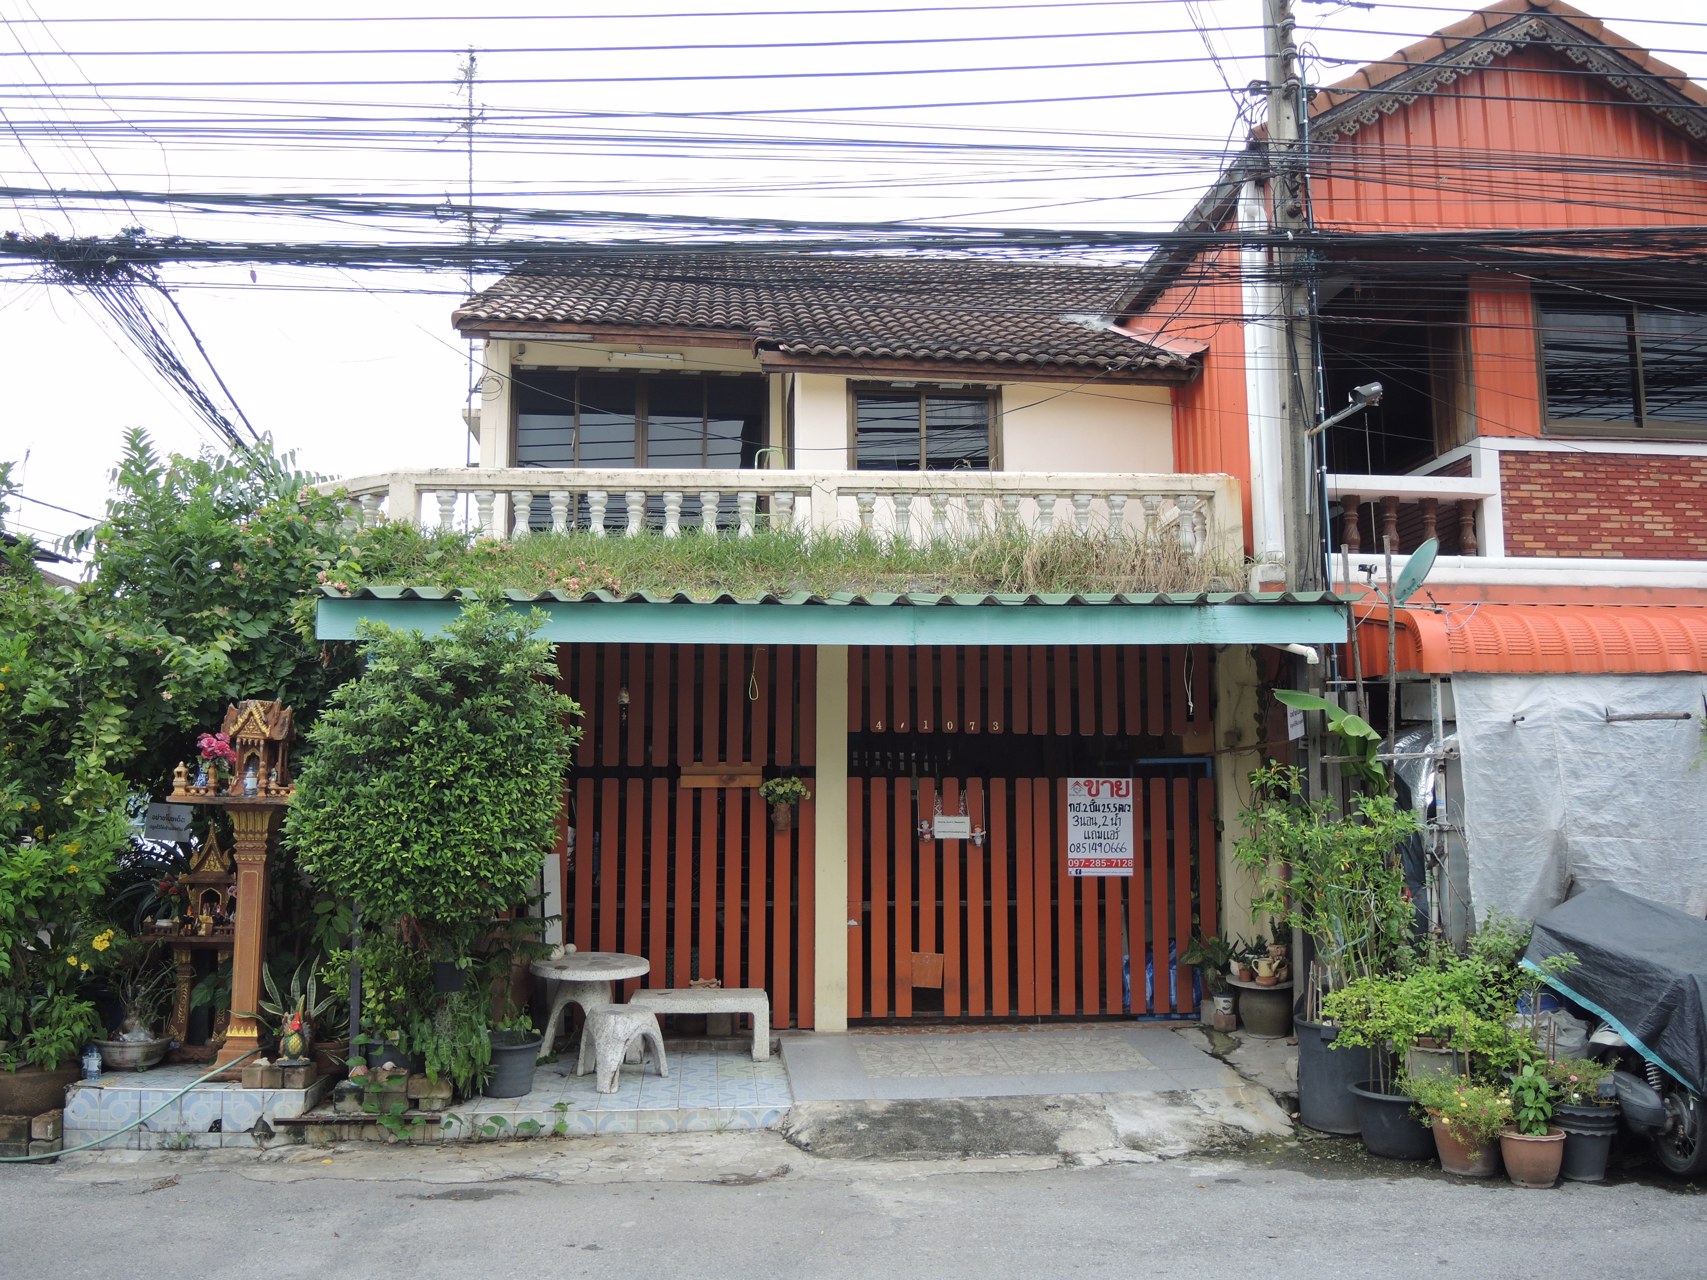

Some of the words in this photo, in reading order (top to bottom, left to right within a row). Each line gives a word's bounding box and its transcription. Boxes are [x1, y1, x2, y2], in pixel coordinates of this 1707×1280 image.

[1083, 780, 1130, 797] ขาย
[1069, 842, 1127, 853] 0851490666
[1068, 859, 1133, 867] 097-285-7128
